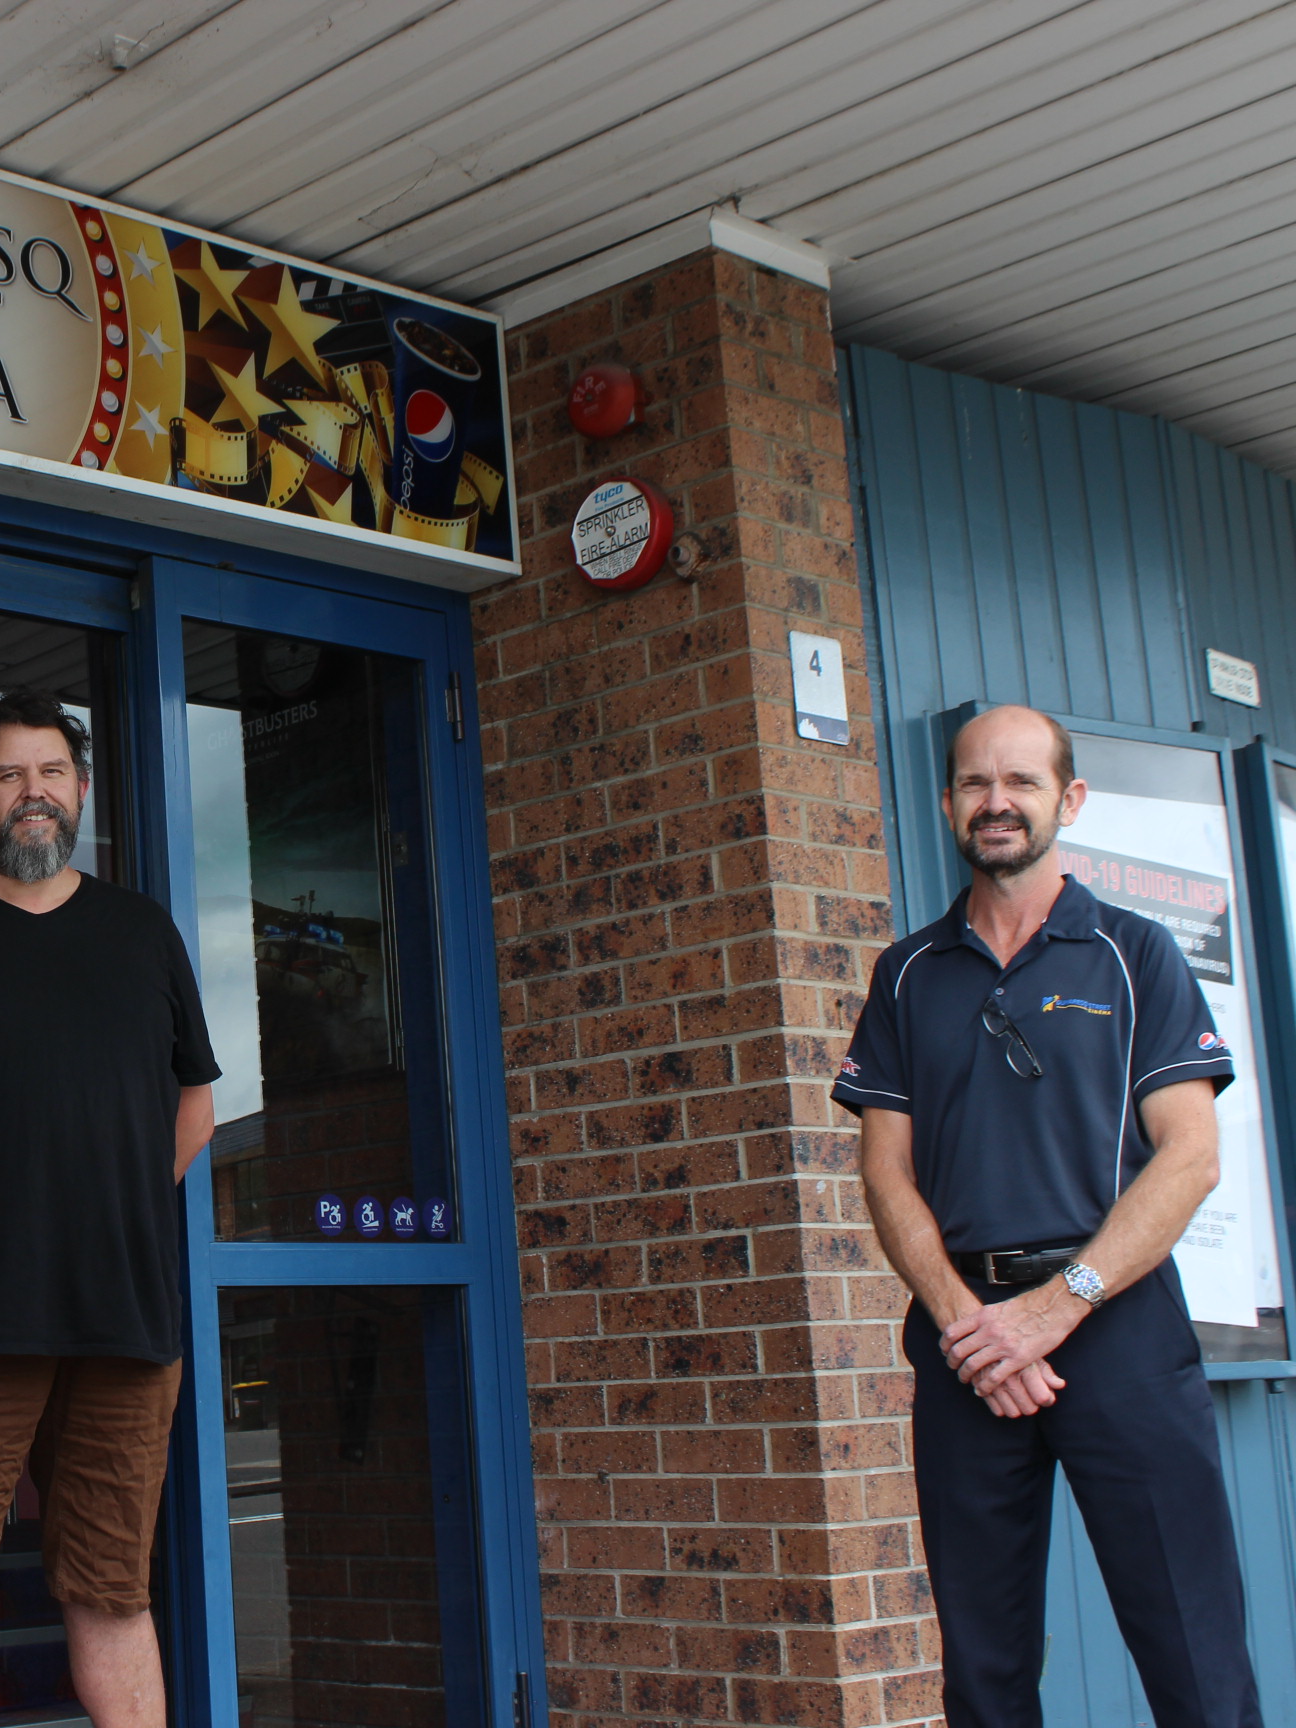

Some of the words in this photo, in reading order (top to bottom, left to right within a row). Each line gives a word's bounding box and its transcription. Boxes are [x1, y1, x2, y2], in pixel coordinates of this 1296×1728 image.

[593, 484, 624, 505] tyco
[578, 498, 645, 538] SPRINKLER
[580, 522, 650, 564] FIRE-ALARM
[593, 565, 609, 577] CALL
[809, 649, 822, 677] 4
[207, 699, 319, 751] GHSTBUSTERS
[1059, 850, 1121, 892] VID-19
[1124, 864, 1226, 915] GUIDELINES
[319, 1200, 330, 1218] P
